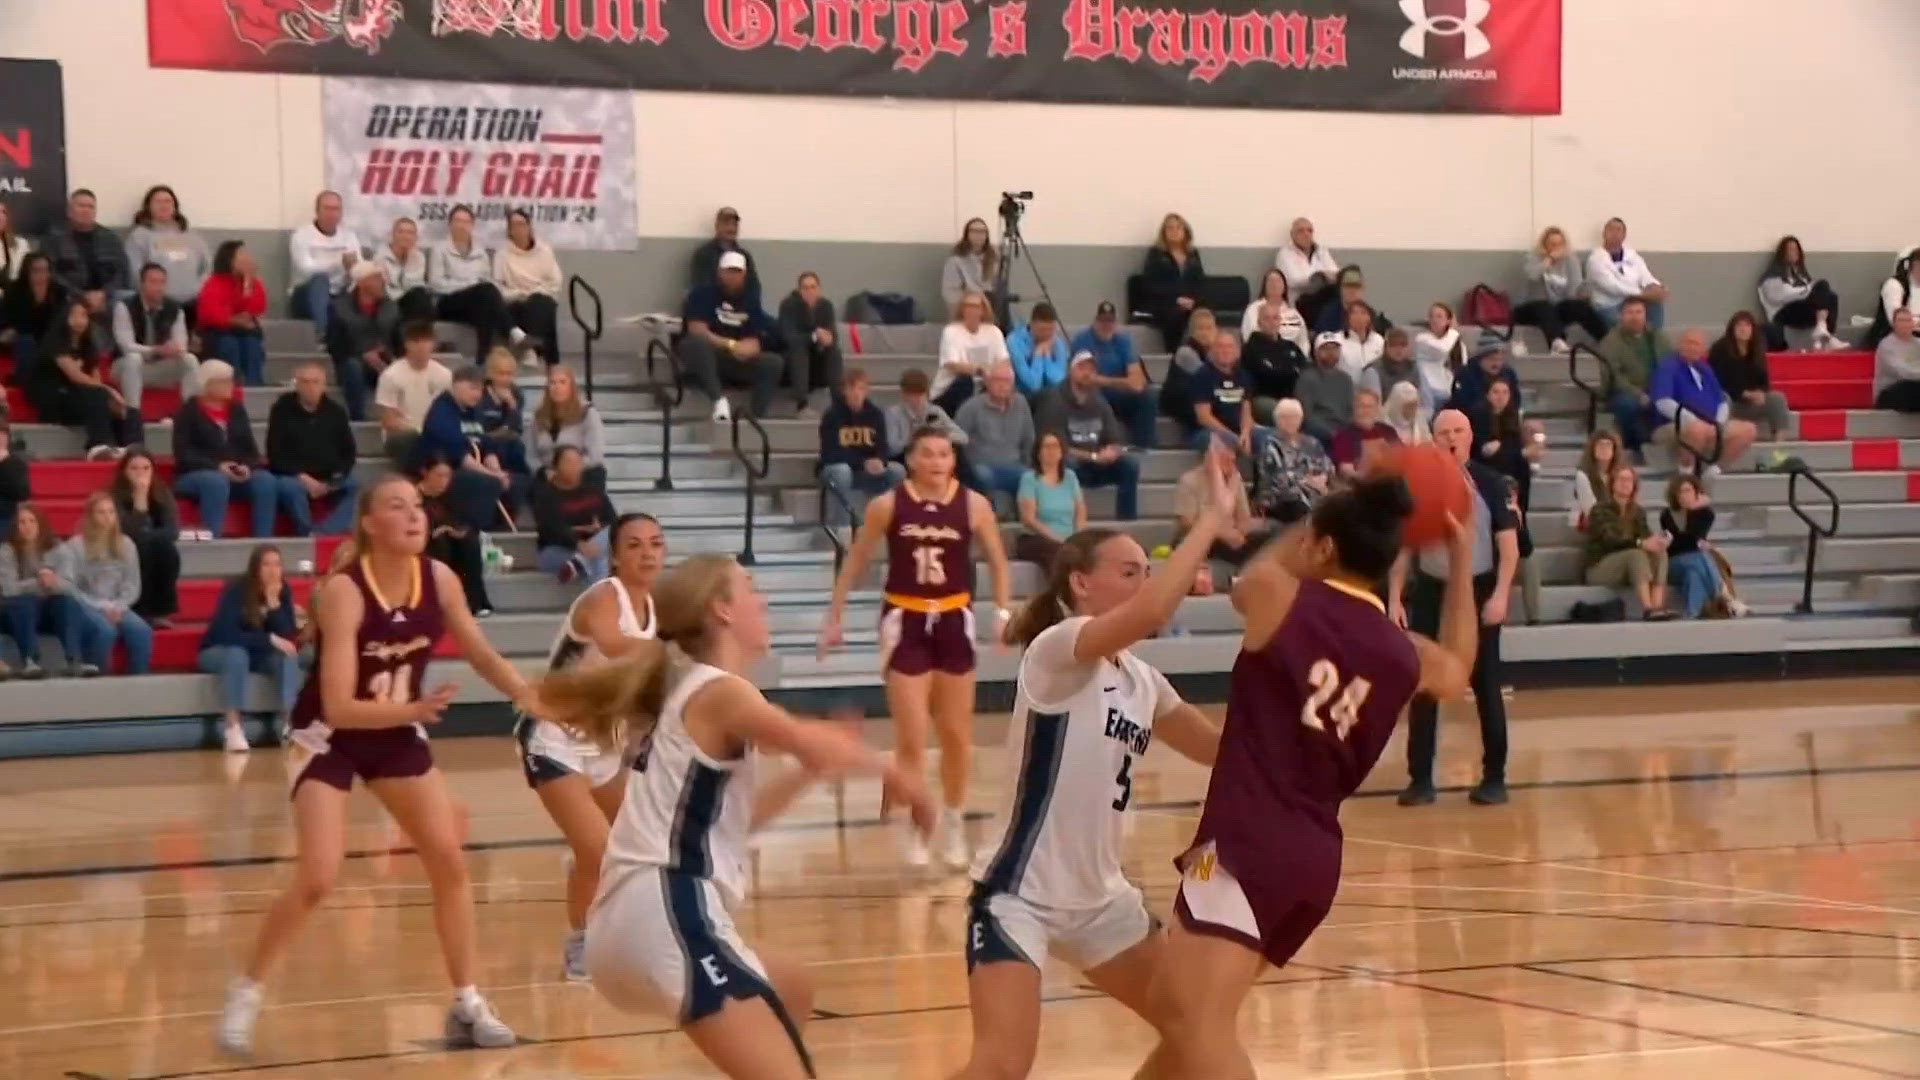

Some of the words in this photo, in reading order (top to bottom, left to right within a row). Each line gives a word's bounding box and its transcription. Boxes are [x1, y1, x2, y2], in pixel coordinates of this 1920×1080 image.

[703, 0, 1027, 73] Georges
[1063, 0, 1348, 84] Dragons
[1392, 67, 1437, 80] UNDER
[1438, 67, 1498, 80] ARMOUR
[365, 104, 542, 142] OPERATION
[360, 149, 471, 196] HOLY
[481, 152, 601, 199] GRAIL
[521, 204, 567, 222] ATION
[912, 545, 948, 586] 15
[1301, 658, 1372, 742] 24
[1112, 754, 1132, 812] 5
[973, 921, 985, 951] E
[699, 953, 729, 986] E
